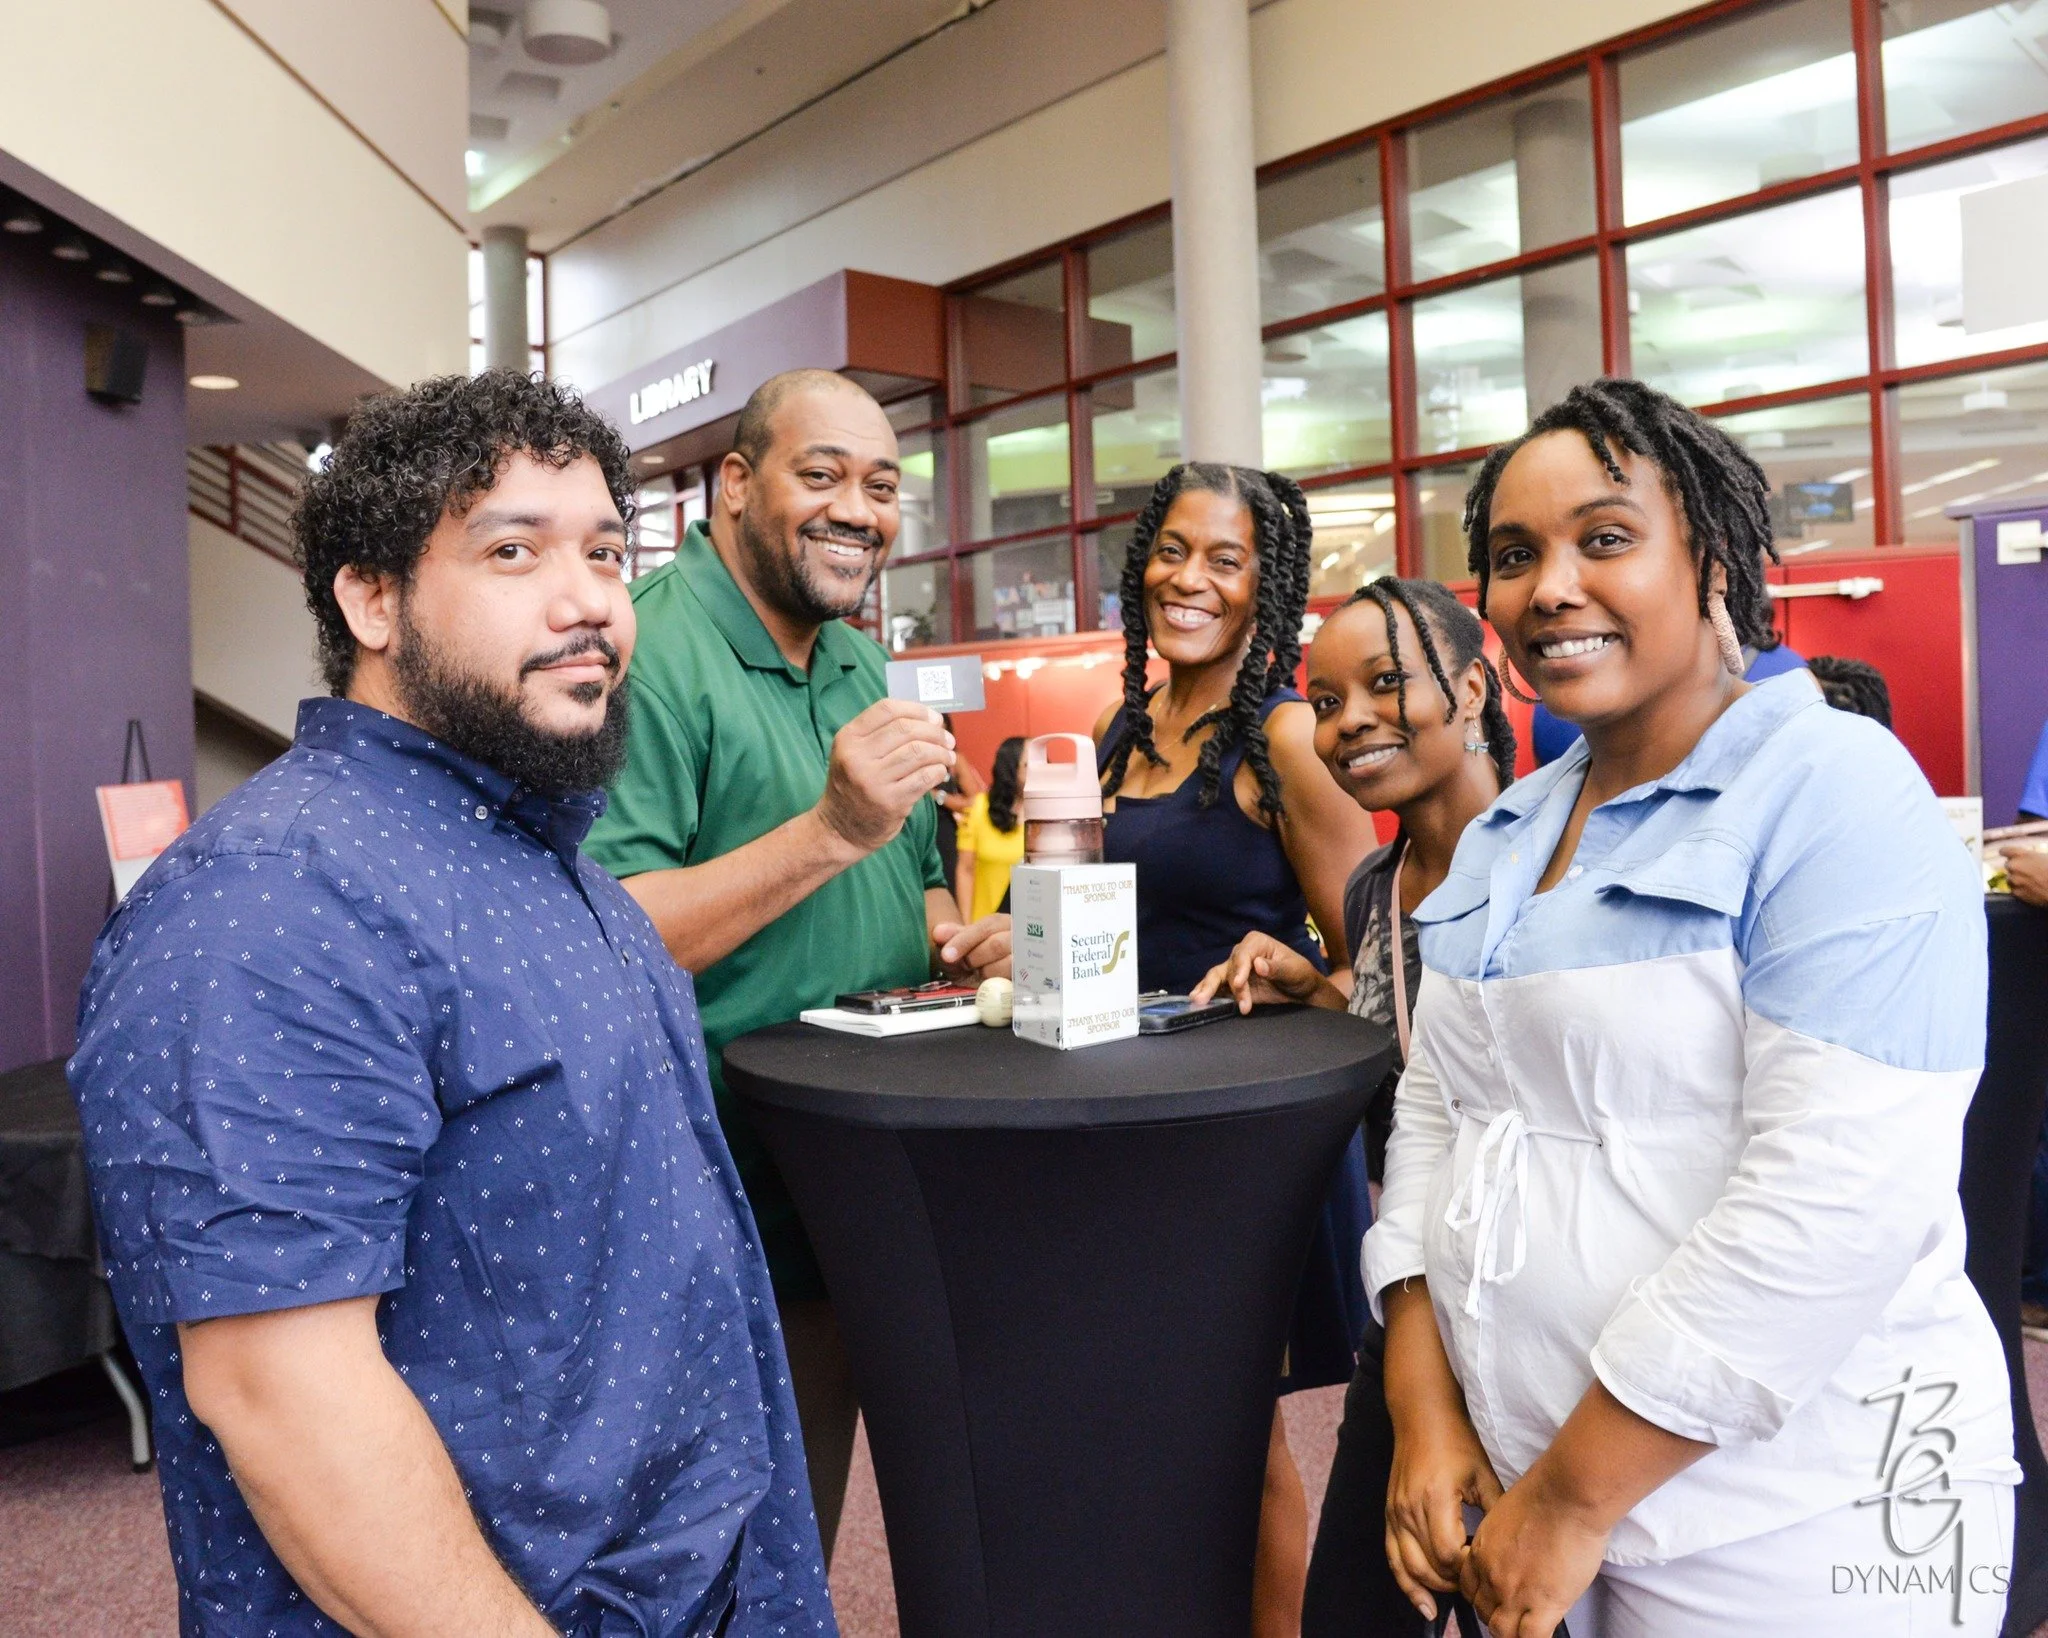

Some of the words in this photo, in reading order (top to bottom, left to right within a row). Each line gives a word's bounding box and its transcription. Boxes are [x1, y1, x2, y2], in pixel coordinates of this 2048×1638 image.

[629, 358, 714, 425] LIBRARY
[1091, 882, 1106, 892] YOU
[1106, 881, 1117, 891] TO
[1118, 879, 1134, 890] OUR
[1083, 891, 1117, 903] SPONSOR
[1027, 923, 1044, 937] SRP
[1071, 930, 1116, 949] Security
[1071, 944, 1111, 965] Federal
[1072, 962, 1101, 981] Bank
[1094, 1011, 1110, 1023] YOU
[1110, 1009, 1121, 1020] TO
[1121, 1006, 1136, 1018] OUR
[1087, 1020, 1121, 1035] SPONSOR
